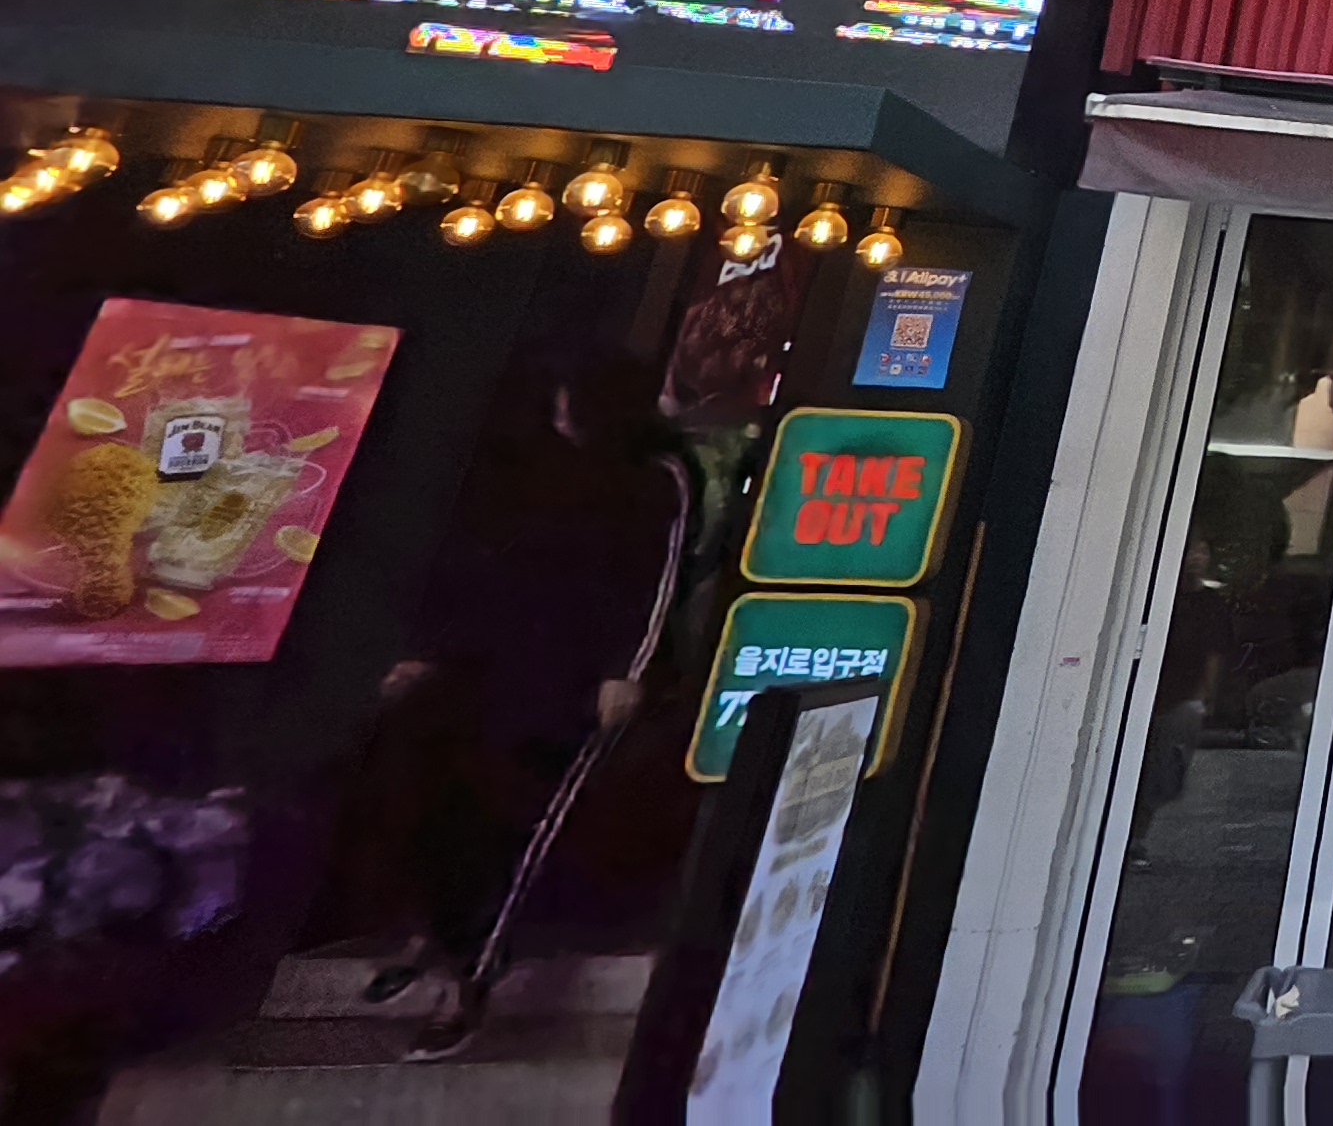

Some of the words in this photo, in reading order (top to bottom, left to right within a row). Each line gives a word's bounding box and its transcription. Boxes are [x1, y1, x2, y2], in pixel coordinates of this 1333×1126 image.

[797, 452, 926, 500] TAKE
[792, 500, 900, 546] OUT
[734, 645, 889, 679] 을지로입구점
